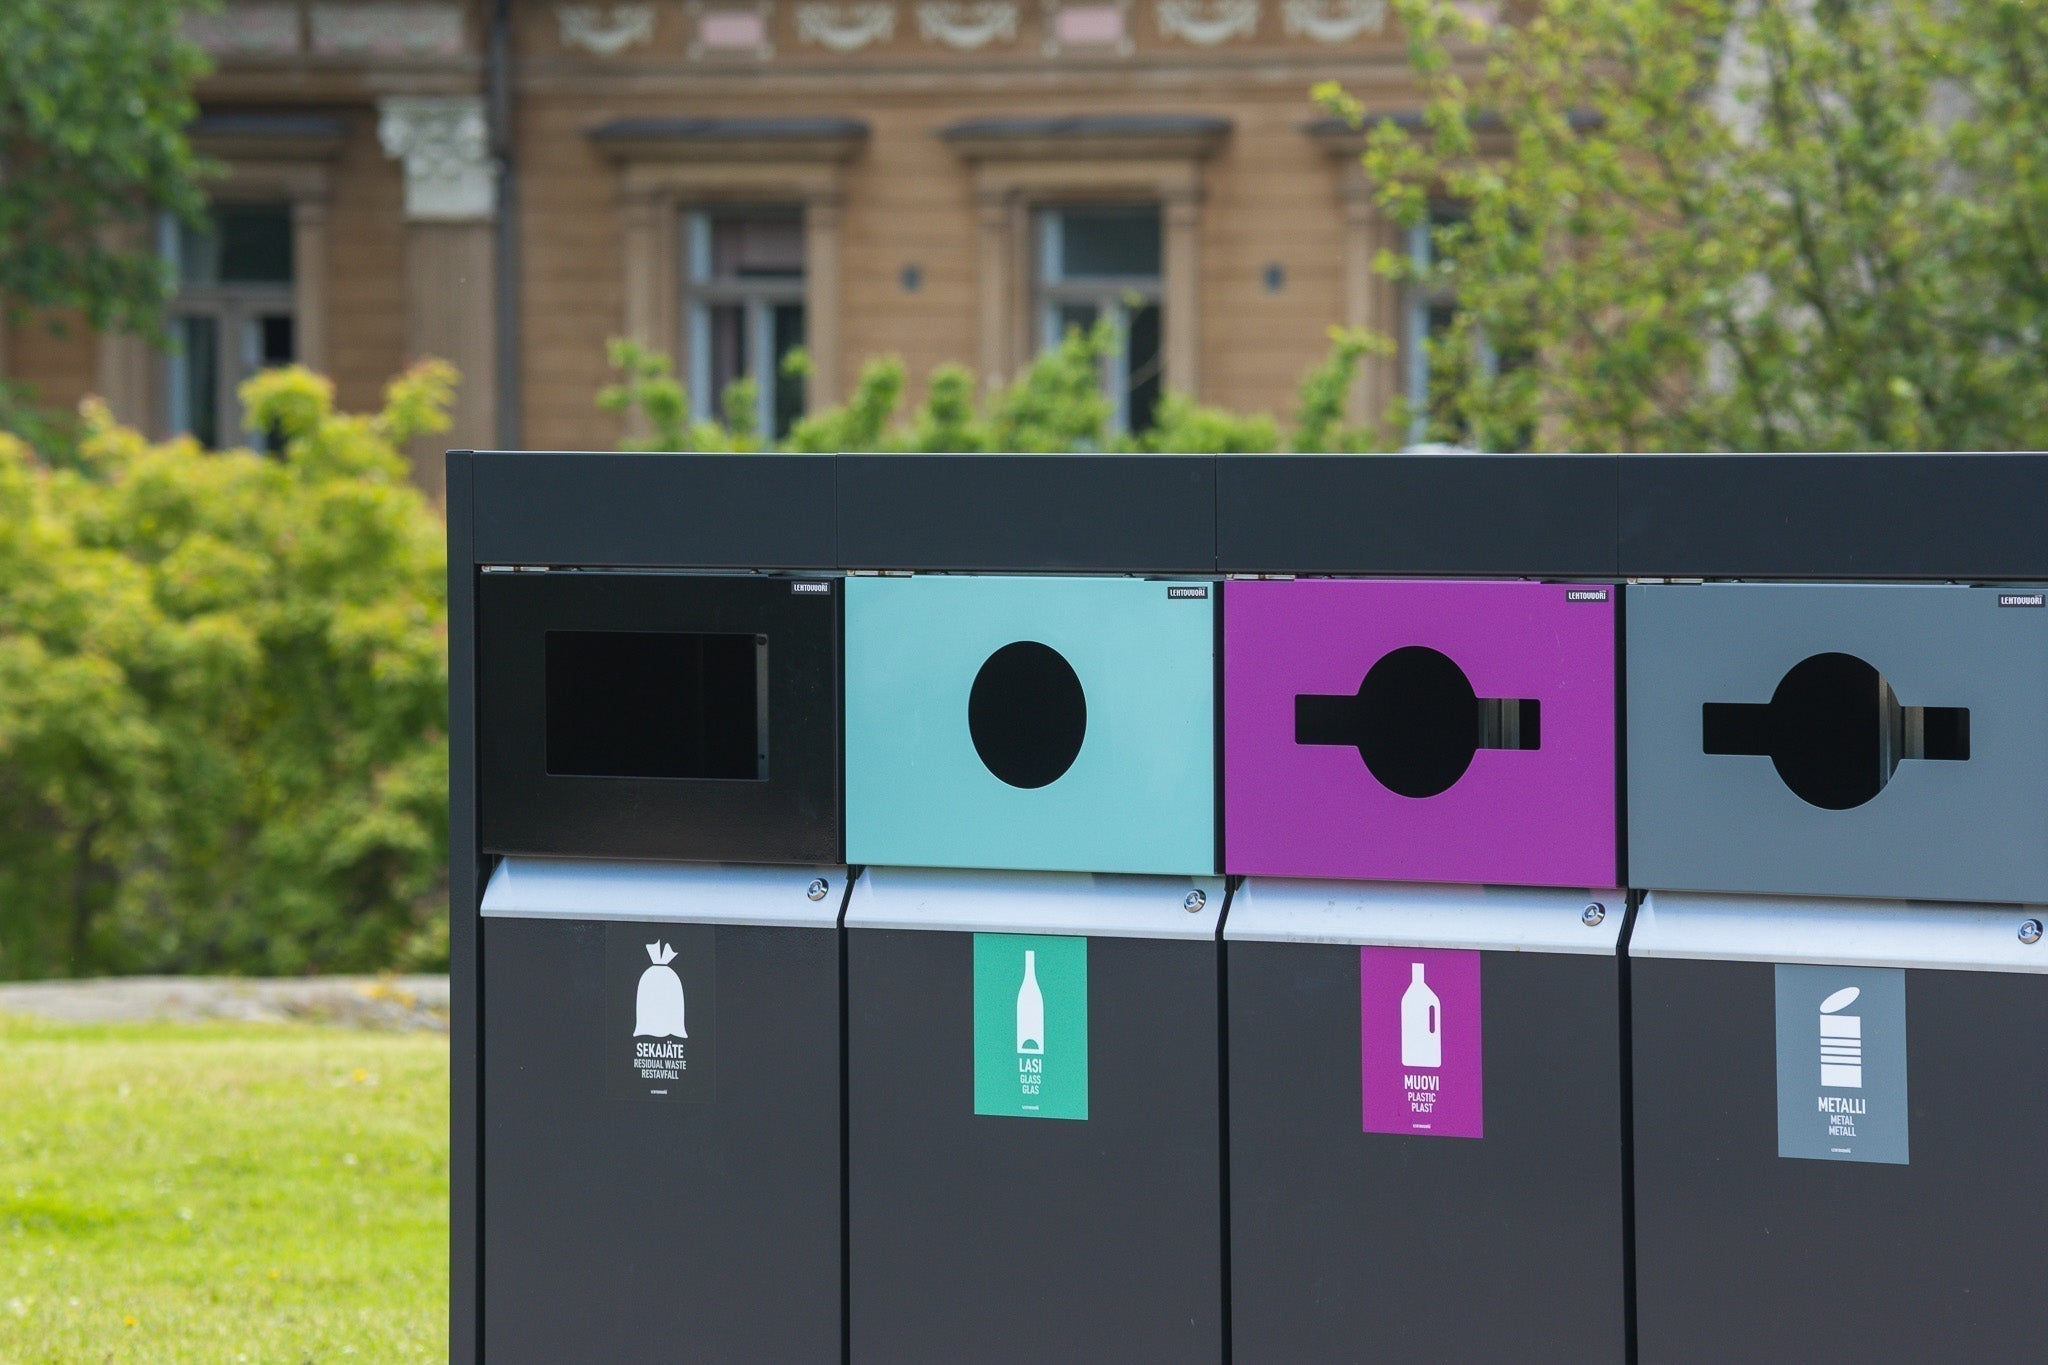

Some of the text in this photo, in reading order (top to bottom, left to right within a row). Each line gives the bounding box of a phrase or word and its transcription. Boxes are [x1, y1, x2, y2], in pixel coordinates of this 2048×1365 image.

[636, 1040, 684, 1059] SEKAJÄTE
[633, 1058, 687, 1070] RESIDUAL WASTE
[1019, 1057, 1042, 1073] LASI
[641, 1069, 679, 1080] RESTAVFALL
[1020, 1074, 1041, 1085] GLASS
[1404, 1074, 1440, 1091] MUOVI
[1022, 1084, 1039, 1095] GLAS
[1407, 1091, 1436, 1103] PLASTIC
[1411, 1102, 1433, 1113] PLAST
[1818, 1096, 1866, 1115] METALLI
[1830, 1114, 1854, 1126] METAL
[1828, 1125, 1857, 1137] METALL
